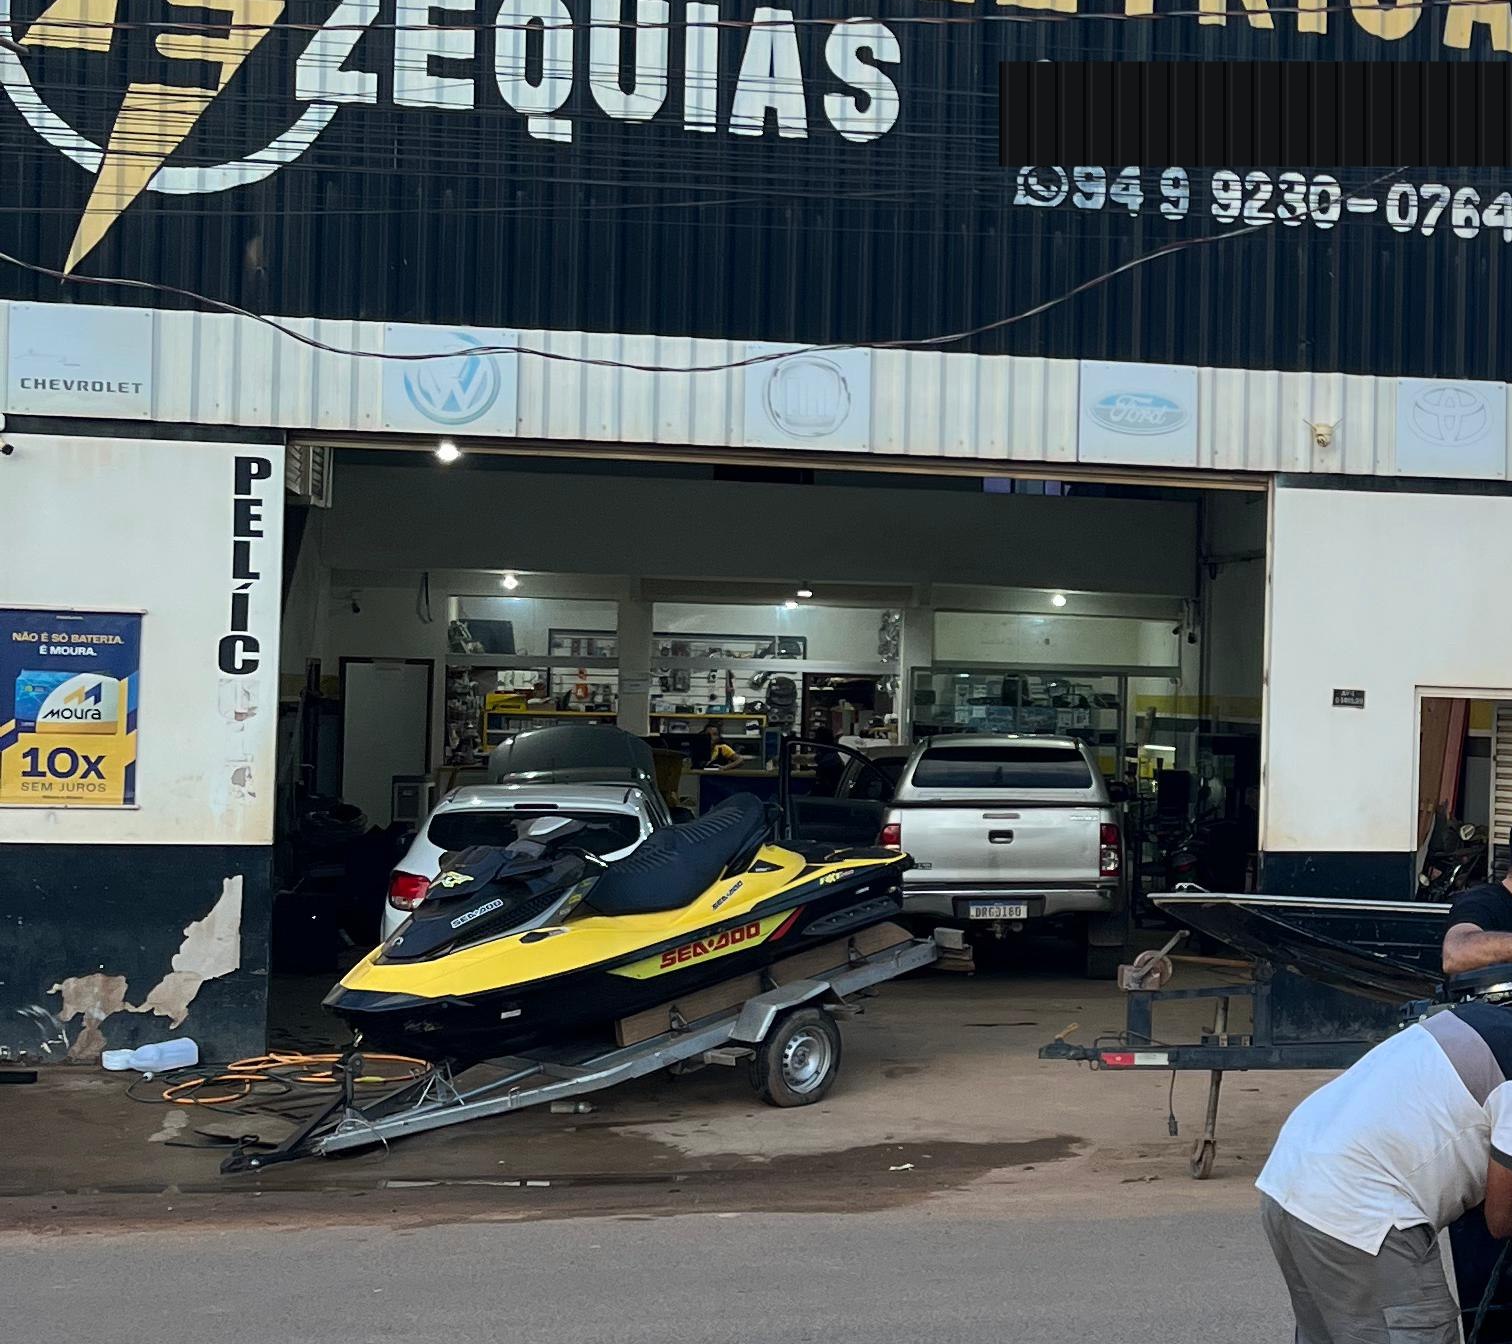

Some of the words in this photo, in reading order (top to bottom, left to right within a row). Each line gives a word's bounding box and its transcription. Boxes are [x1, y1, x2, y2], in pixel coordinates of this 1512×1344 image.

[1072, 166, 1144, 217] 94
[1160, 166, 1190, 220] 9
[20, 377, 143, 394] CHEVROLET
[1110, 395, 1170, 425] Ford
[218, 456, 272, 674] PELÍC
[12, 631, 38, 642] NÃO
[41, 631, 49, 642] É
[51, 632, 69, 643] SÓ
[71, 633, 125, 644] BATERIA.
[39, 644, 47, 655] É
[50, 646, 98, 656] MOURA.
[21, 782, 53, 792] SEM
[59, 783, 106, 792] JUROS
